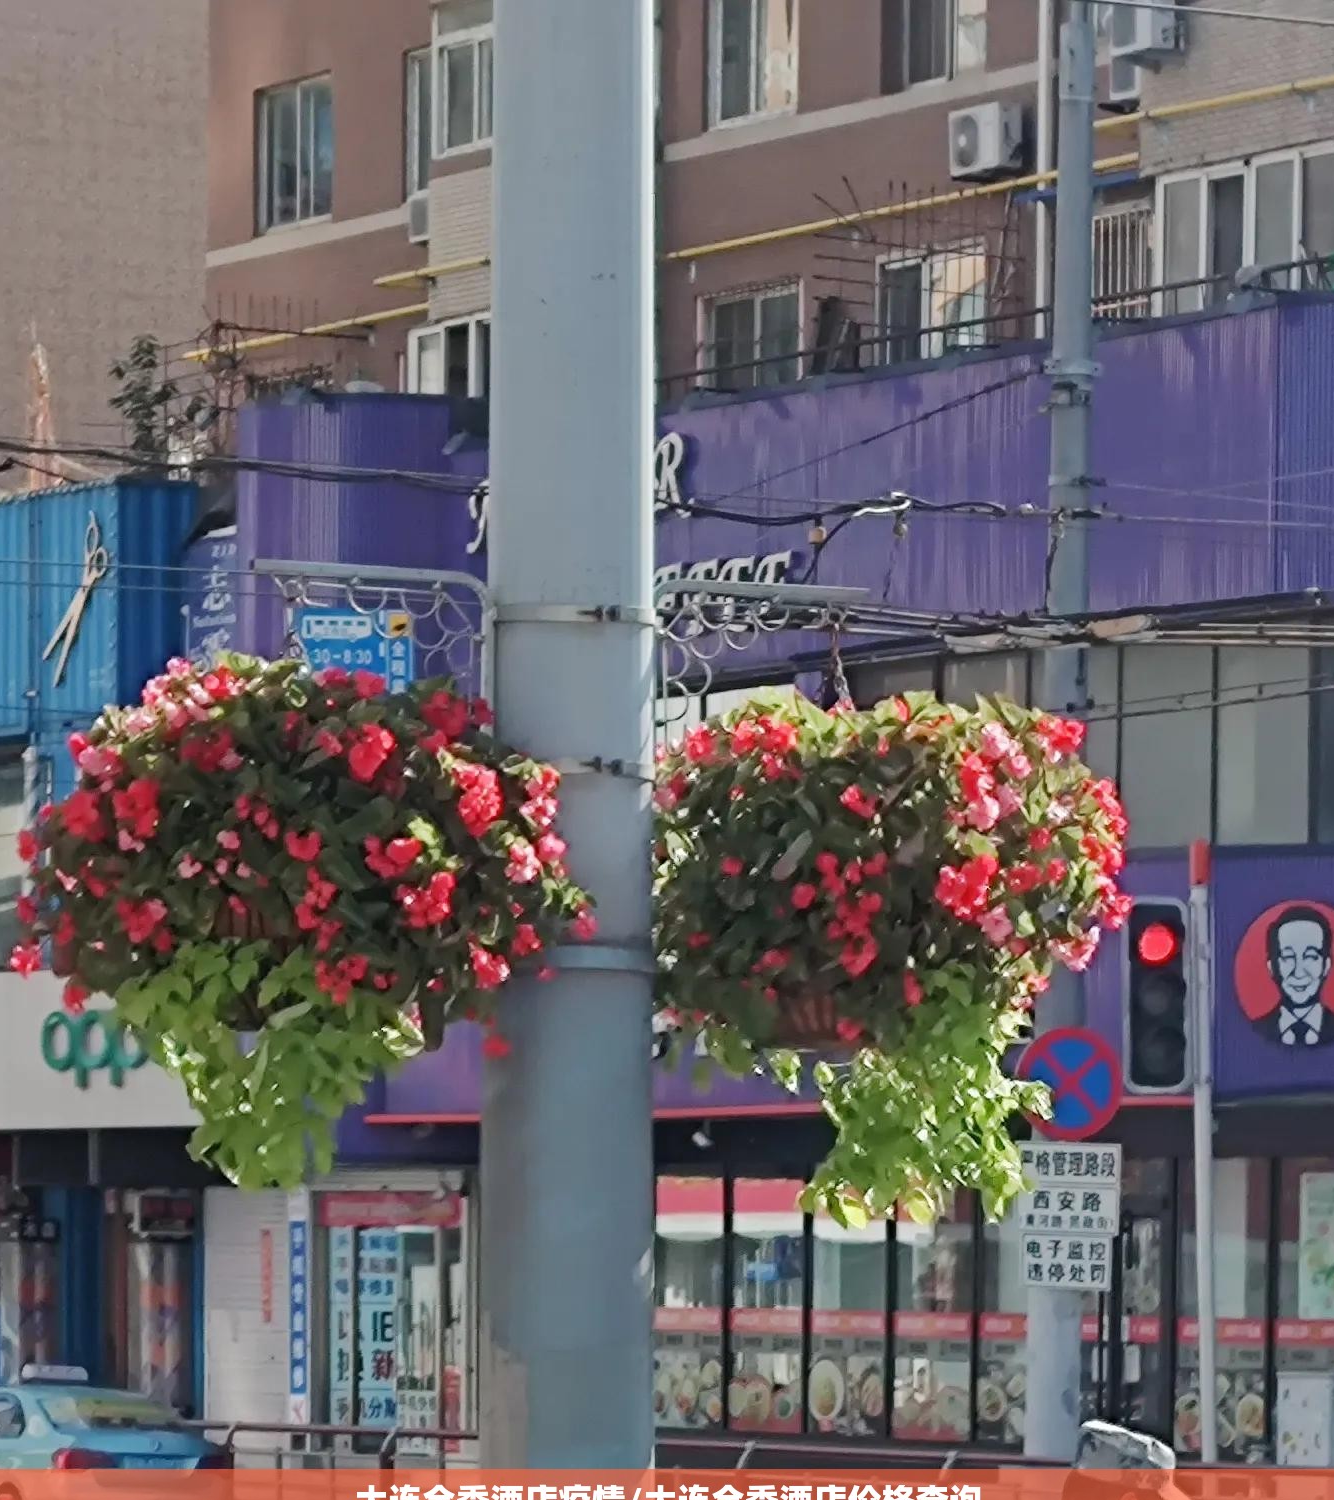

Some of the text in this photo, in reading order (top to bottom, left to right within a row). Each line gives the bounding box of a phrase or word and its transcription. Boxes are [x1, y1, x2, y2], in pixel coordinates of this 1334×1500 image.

[41, 1009, 151, 1090] opp
[1033, 1190, 1102, 1212] 西安路
[1026, 1239, 1106, 1261] 电子监控
